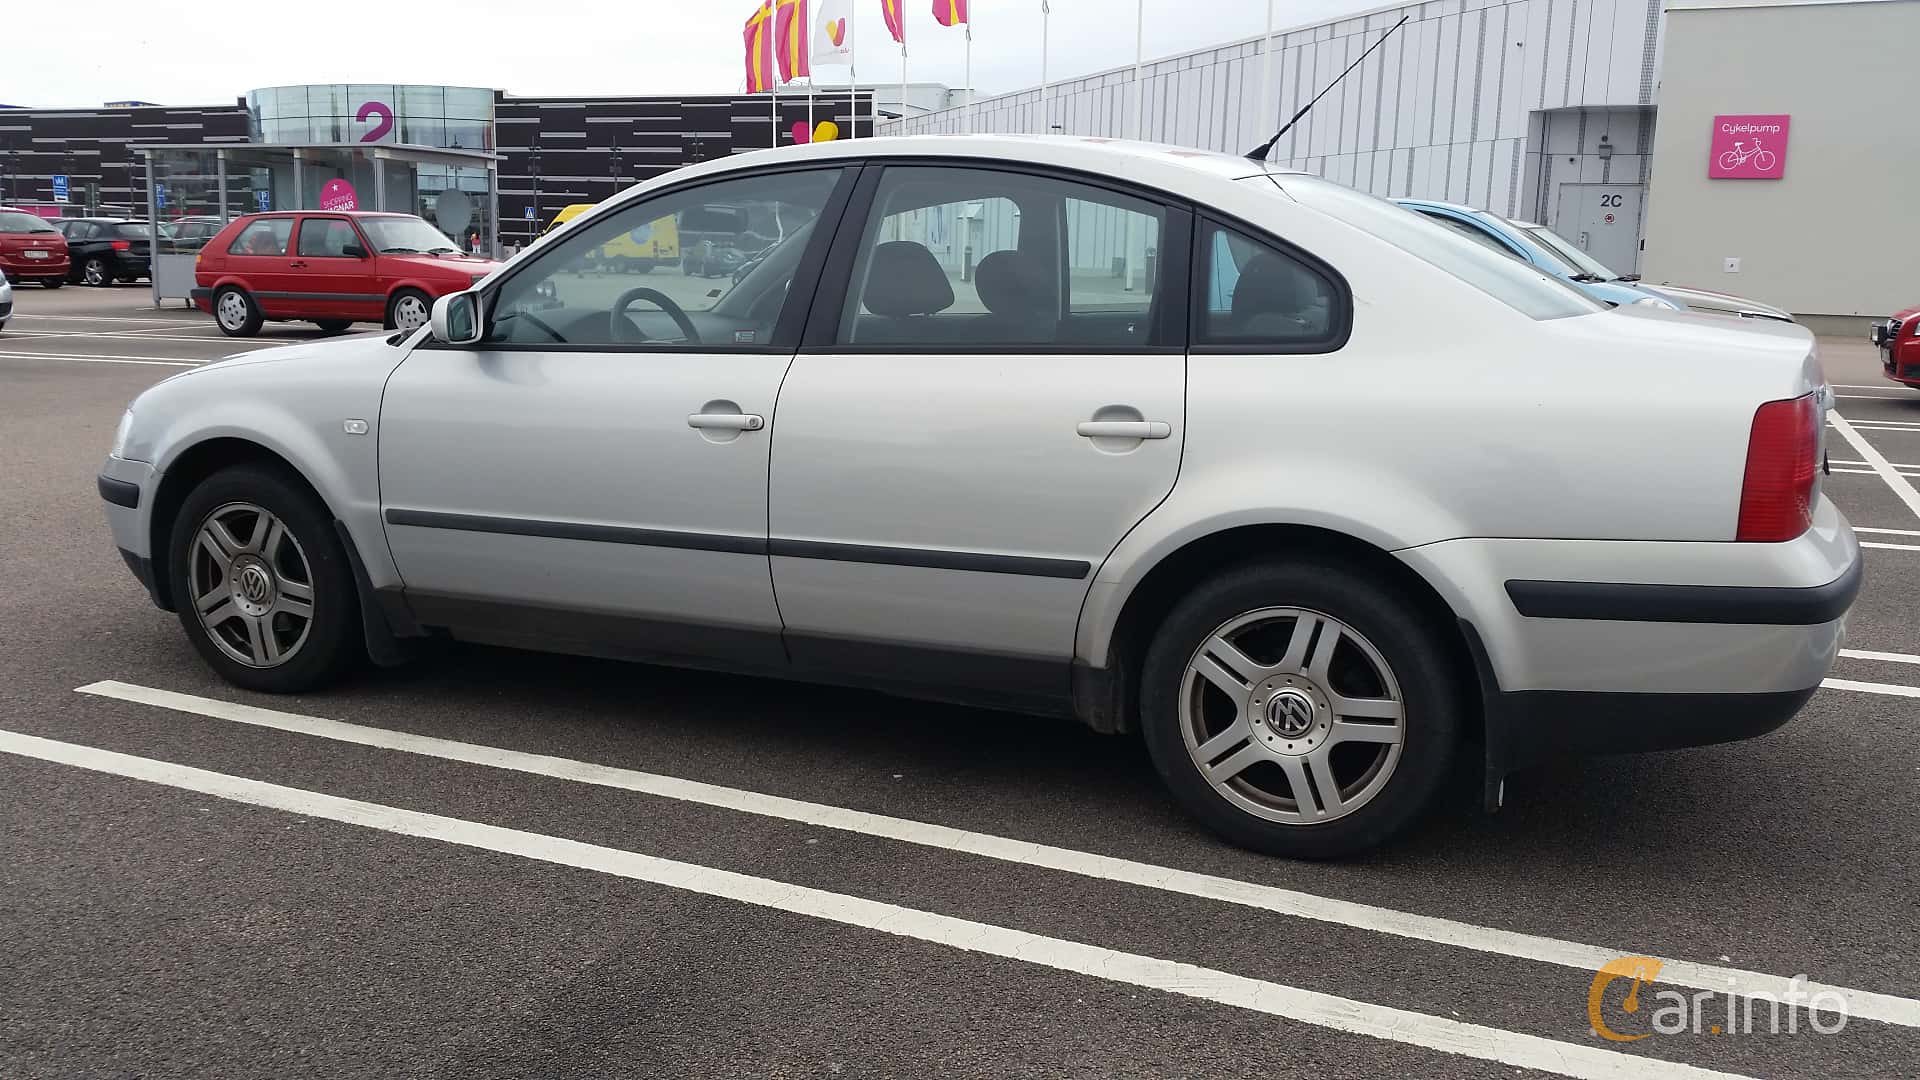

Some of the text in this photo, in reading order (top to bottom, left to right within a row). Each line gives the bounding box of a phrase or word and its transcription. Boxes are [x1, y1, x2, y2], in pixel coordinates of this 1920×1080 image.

[356, 101, 393, 142] 2
[1721, 123, 1780, 134] Cykelpump
[1600, 194, 1622, 207] 2C
